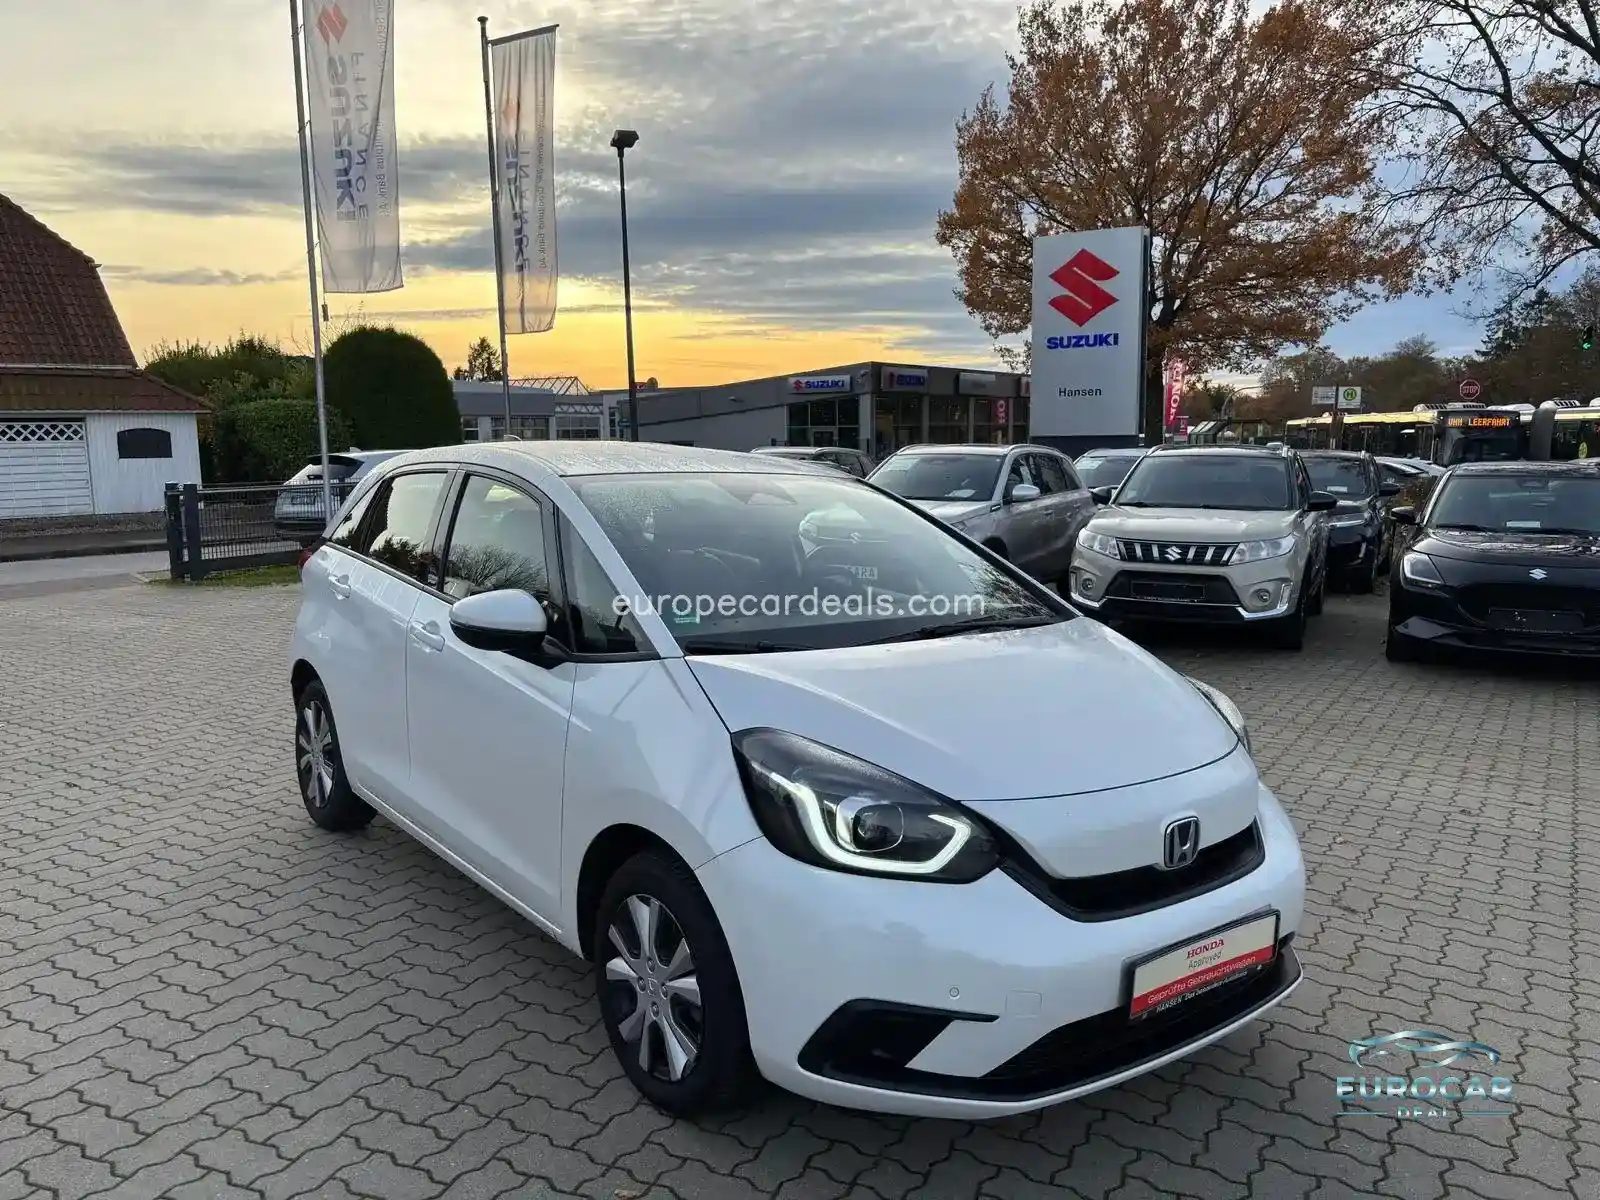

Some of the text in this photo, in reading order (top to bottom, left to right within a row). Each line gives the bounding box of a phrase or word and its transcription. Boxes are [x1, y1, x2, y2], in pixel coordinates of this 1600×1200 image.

[1046, 332, 1120, 350] SUZUKI
[804, 379, 845, 390] SUZUKI
[1058, 387, 1102, 398] Hansen
[1462, 385, 1479, 395] STOP
[1468, 417, 1511, 427] LEERFAHRT
[1186, 938, 1225, 960] HONDA
[1188, 950, 1223, 970] Approved
[1147, 955, 1257, 1004] Geprüfte Gebrauchtwagen
[1156, 996, 1184, 1013] HANSEN
